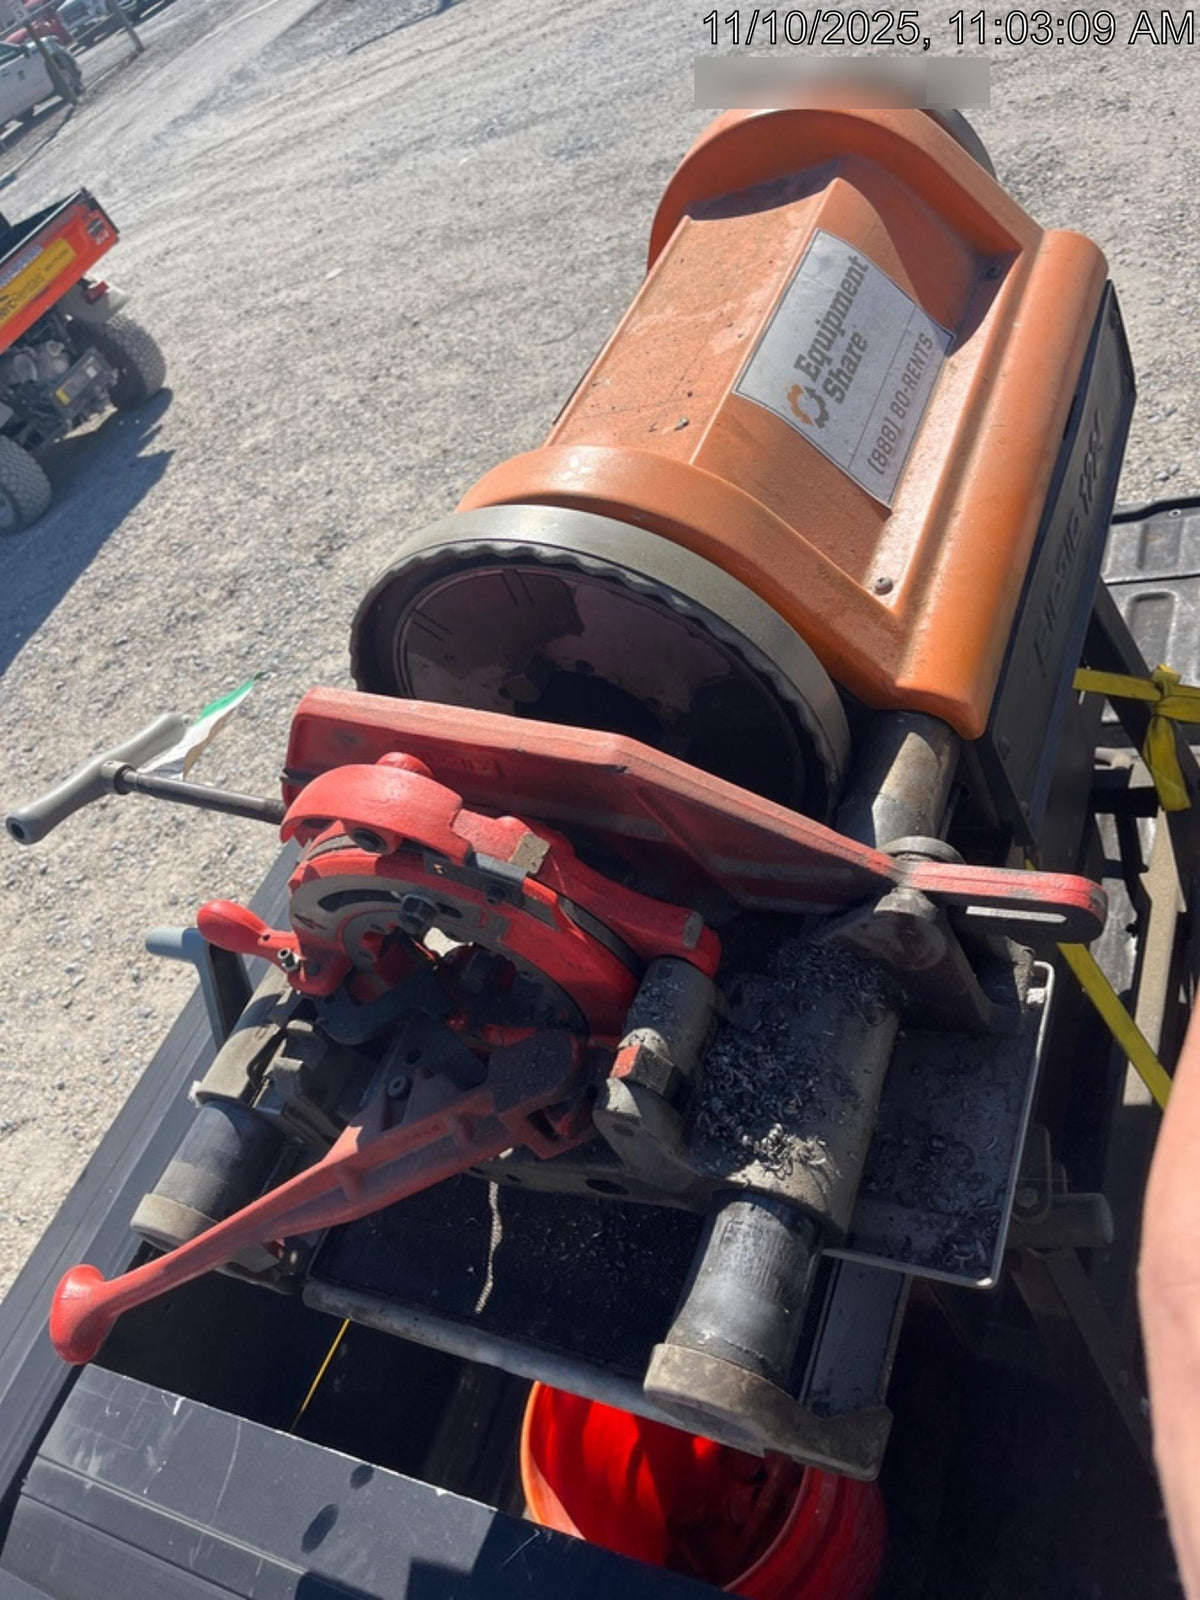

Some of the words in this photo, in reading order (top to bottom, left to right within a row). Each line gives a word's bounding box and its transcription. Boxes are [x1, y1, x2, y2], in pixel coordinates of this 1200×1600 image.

[794, 254, 869, 383] Equipment
[822, 331, 867, 405] Share
[867, 416, 900, 476] (888)
[892, 332, 934, 420] 80-RENTS
